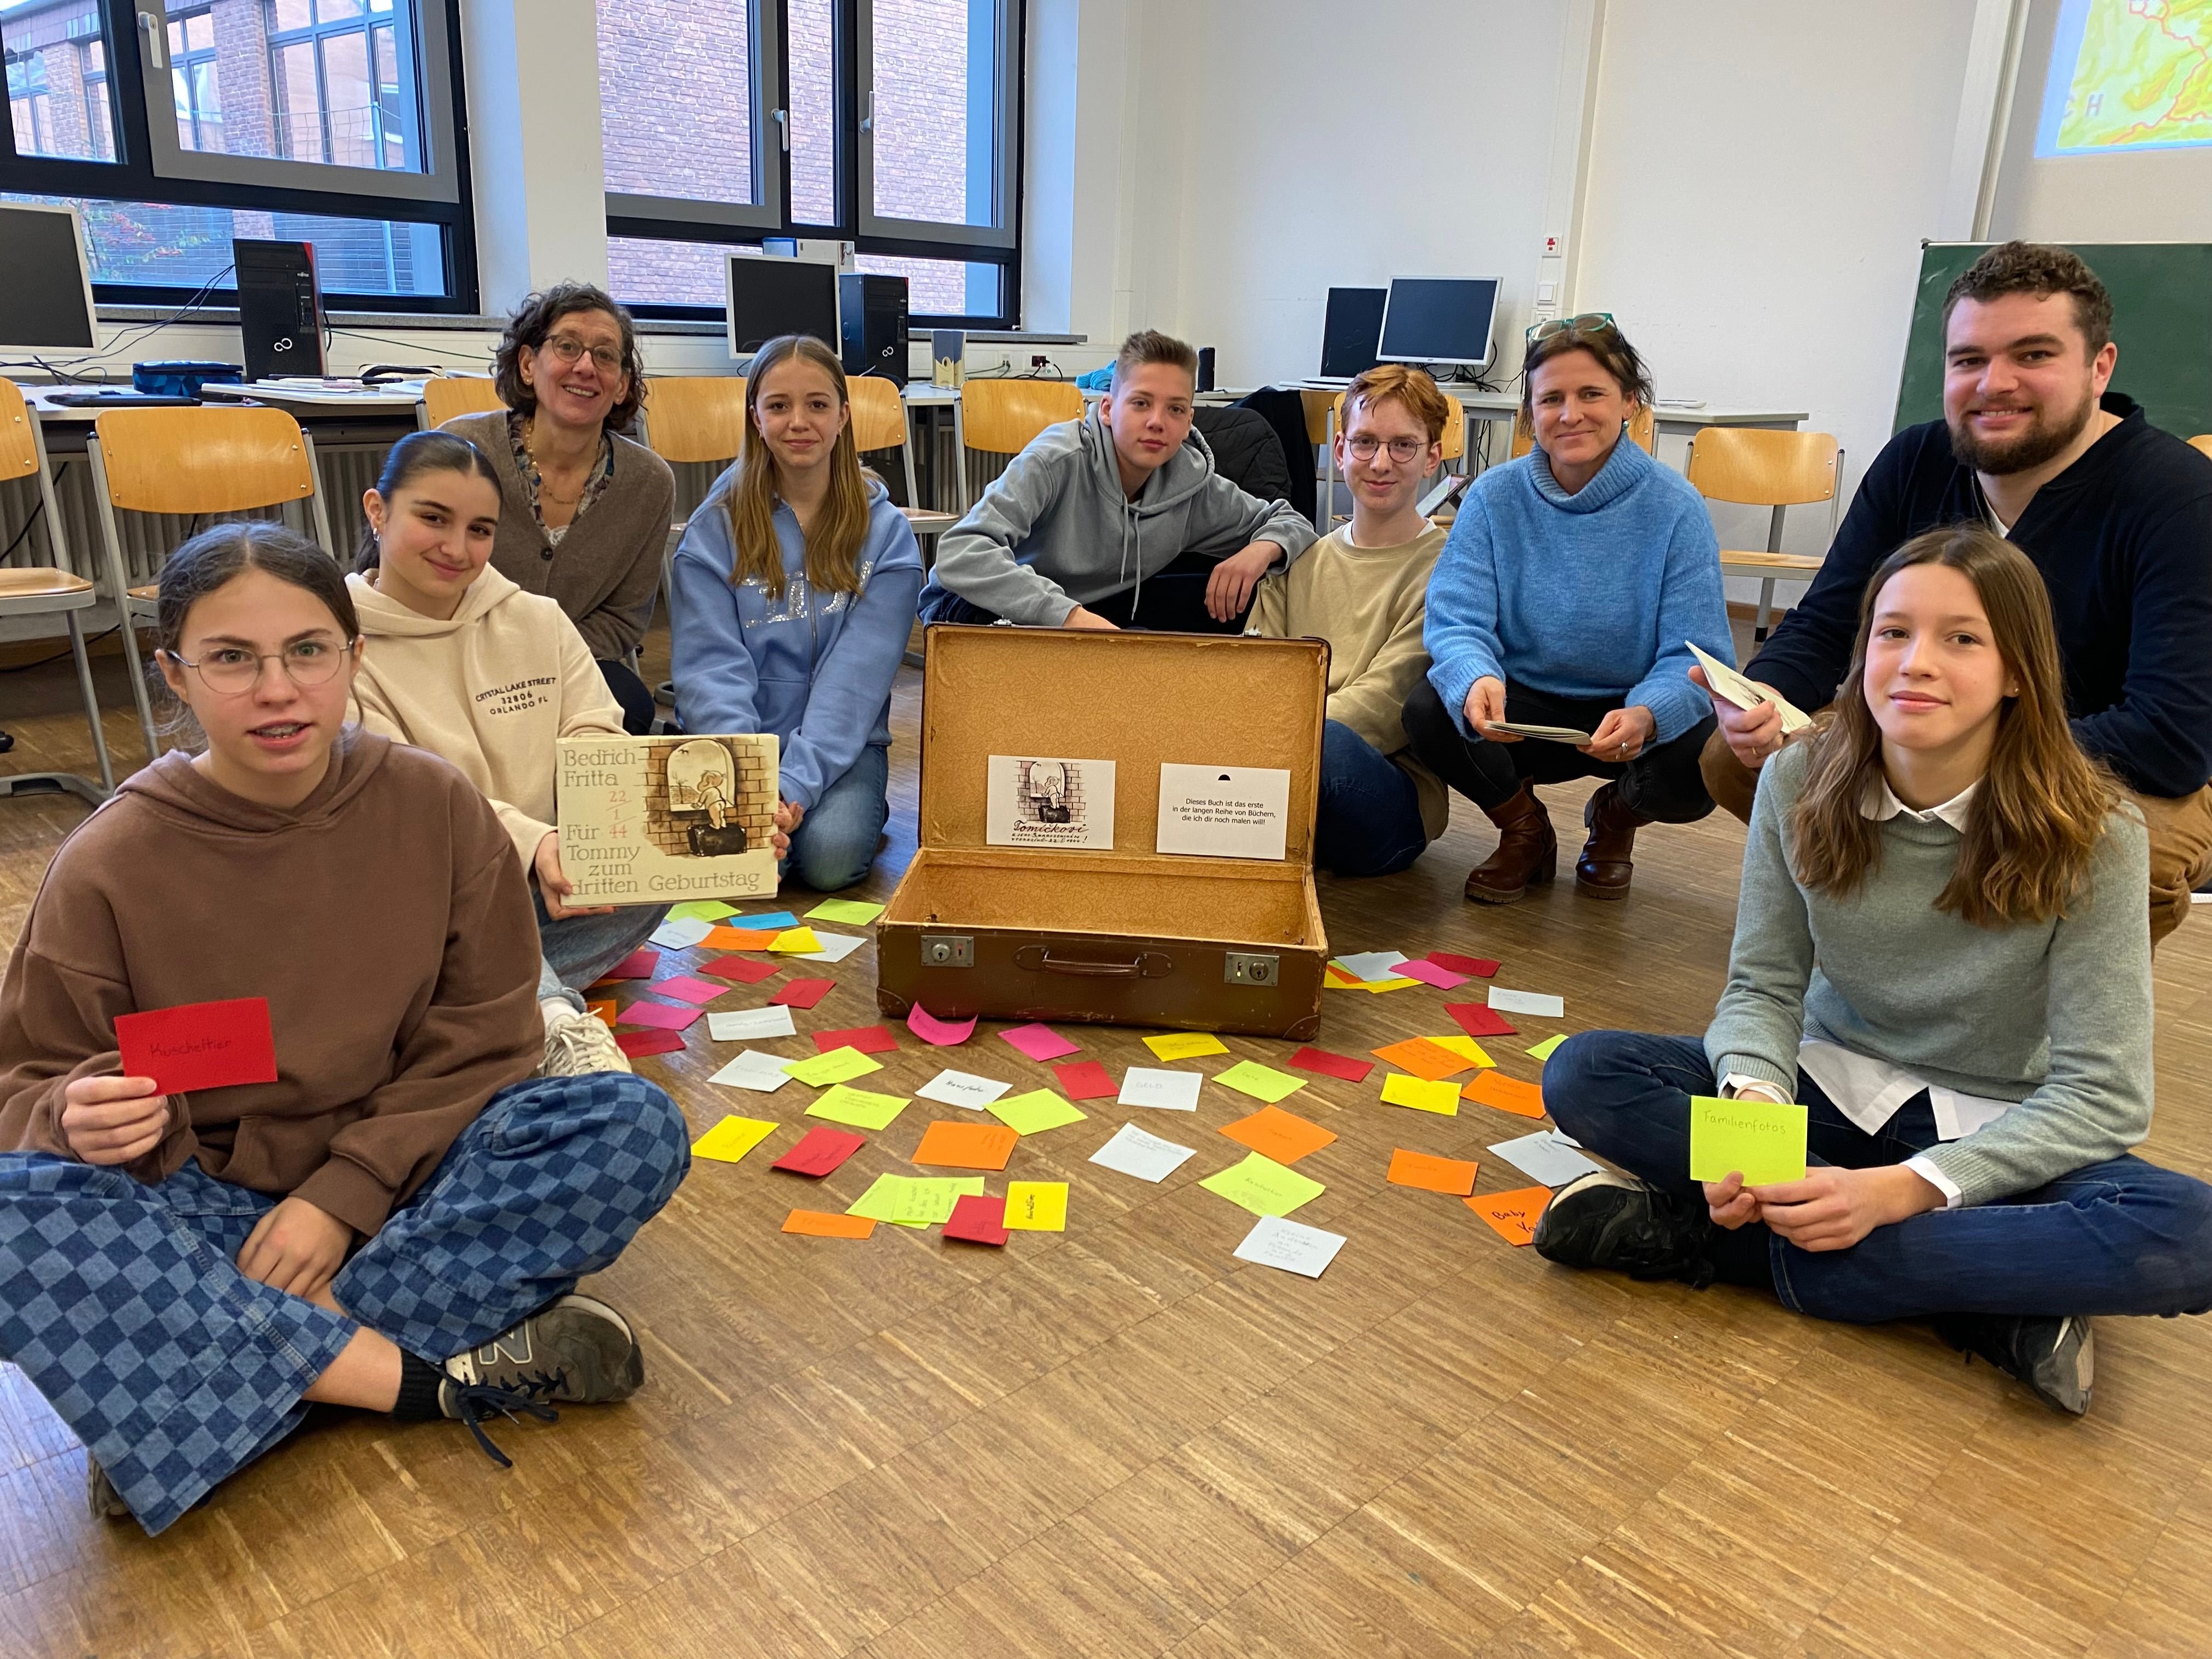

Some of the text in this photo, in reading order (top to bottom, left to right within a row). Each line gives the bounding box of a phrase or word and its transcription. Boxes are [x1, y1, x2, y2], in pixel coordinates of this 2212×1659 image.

[475, 677, 556, 702] CRYSTAL LAKE STREET
[500, 691, 533, 704] 32806
[489, 696, 548, 715] ORLANDO FL
[563, 748, 636, 766] Bedřich
[563, 770, 619, 787] Fritta
[1248, 810, 1276, 819] Büchern,
[566, 824, 600, 840] Für
[566, 845, 640, 862] Tommy
[589, 862, 633, 876] zum
[571, 872, 760, 896] dritten Geburtstag
[1703, 1110, 1786, 1134] Familienfotos
[1491, 1210, 1525, 1220] Baby
